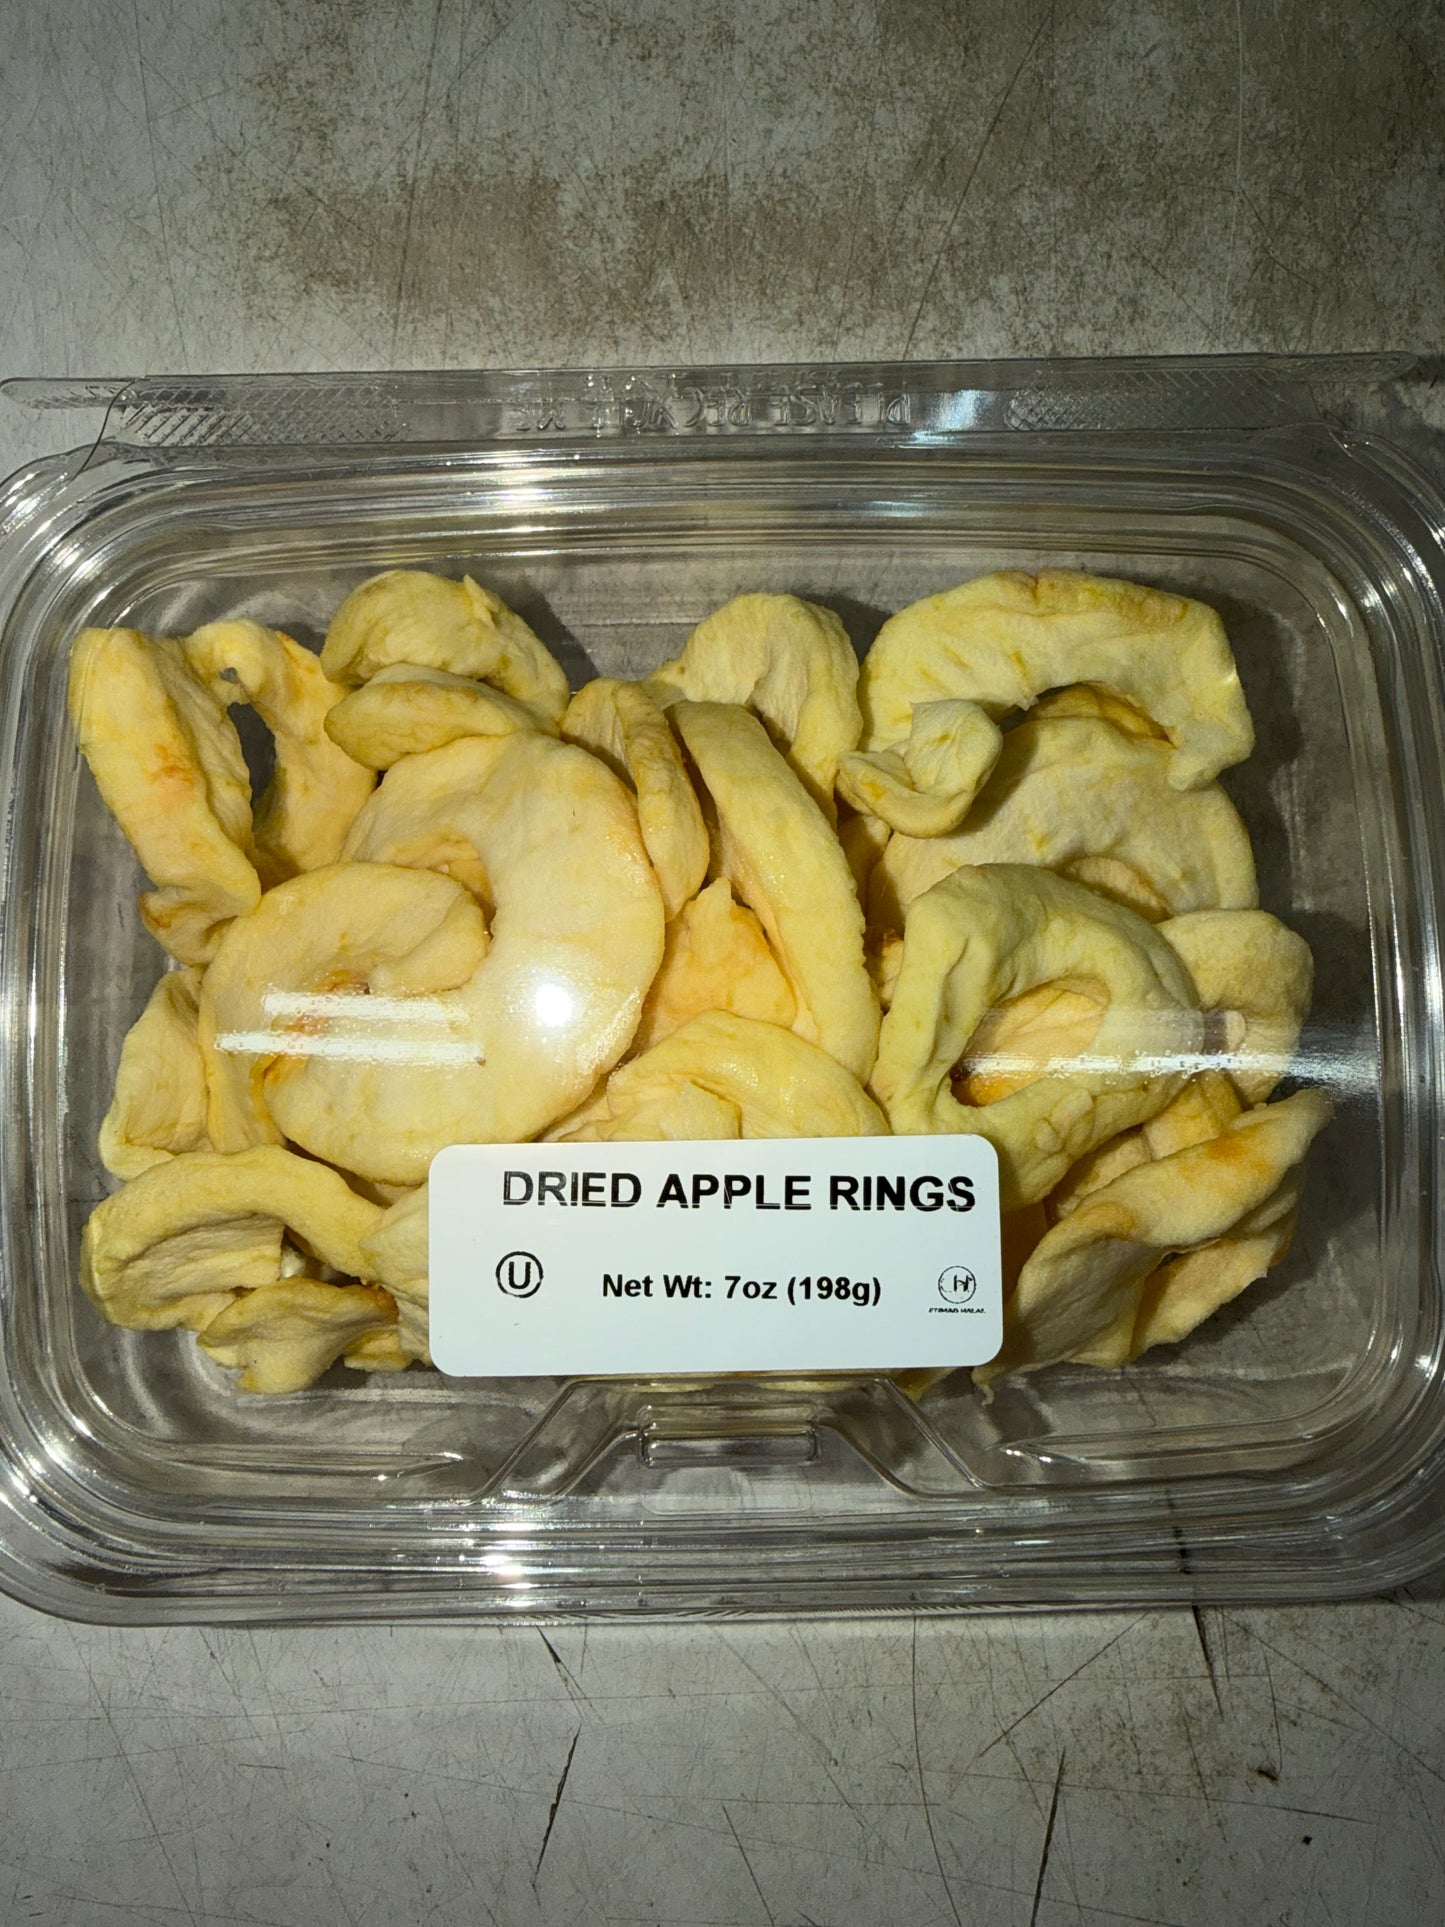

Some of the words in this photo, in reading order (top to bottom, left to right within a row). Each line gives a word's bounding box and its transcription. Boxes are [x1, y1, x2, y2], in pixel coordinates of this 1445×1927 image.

[503, 1171, 642, 1208] DRIED
[656, 1173, 812, 1211] APPLE
[829, 1175, 976, 1212] RINGS
[602, 1273, 654, 1298] Net
[663, 1274, 712, 1299] Wt:
[724, 1275, 778, 1300] 7oz
[787, 1276, 882, 1307] (198g)
